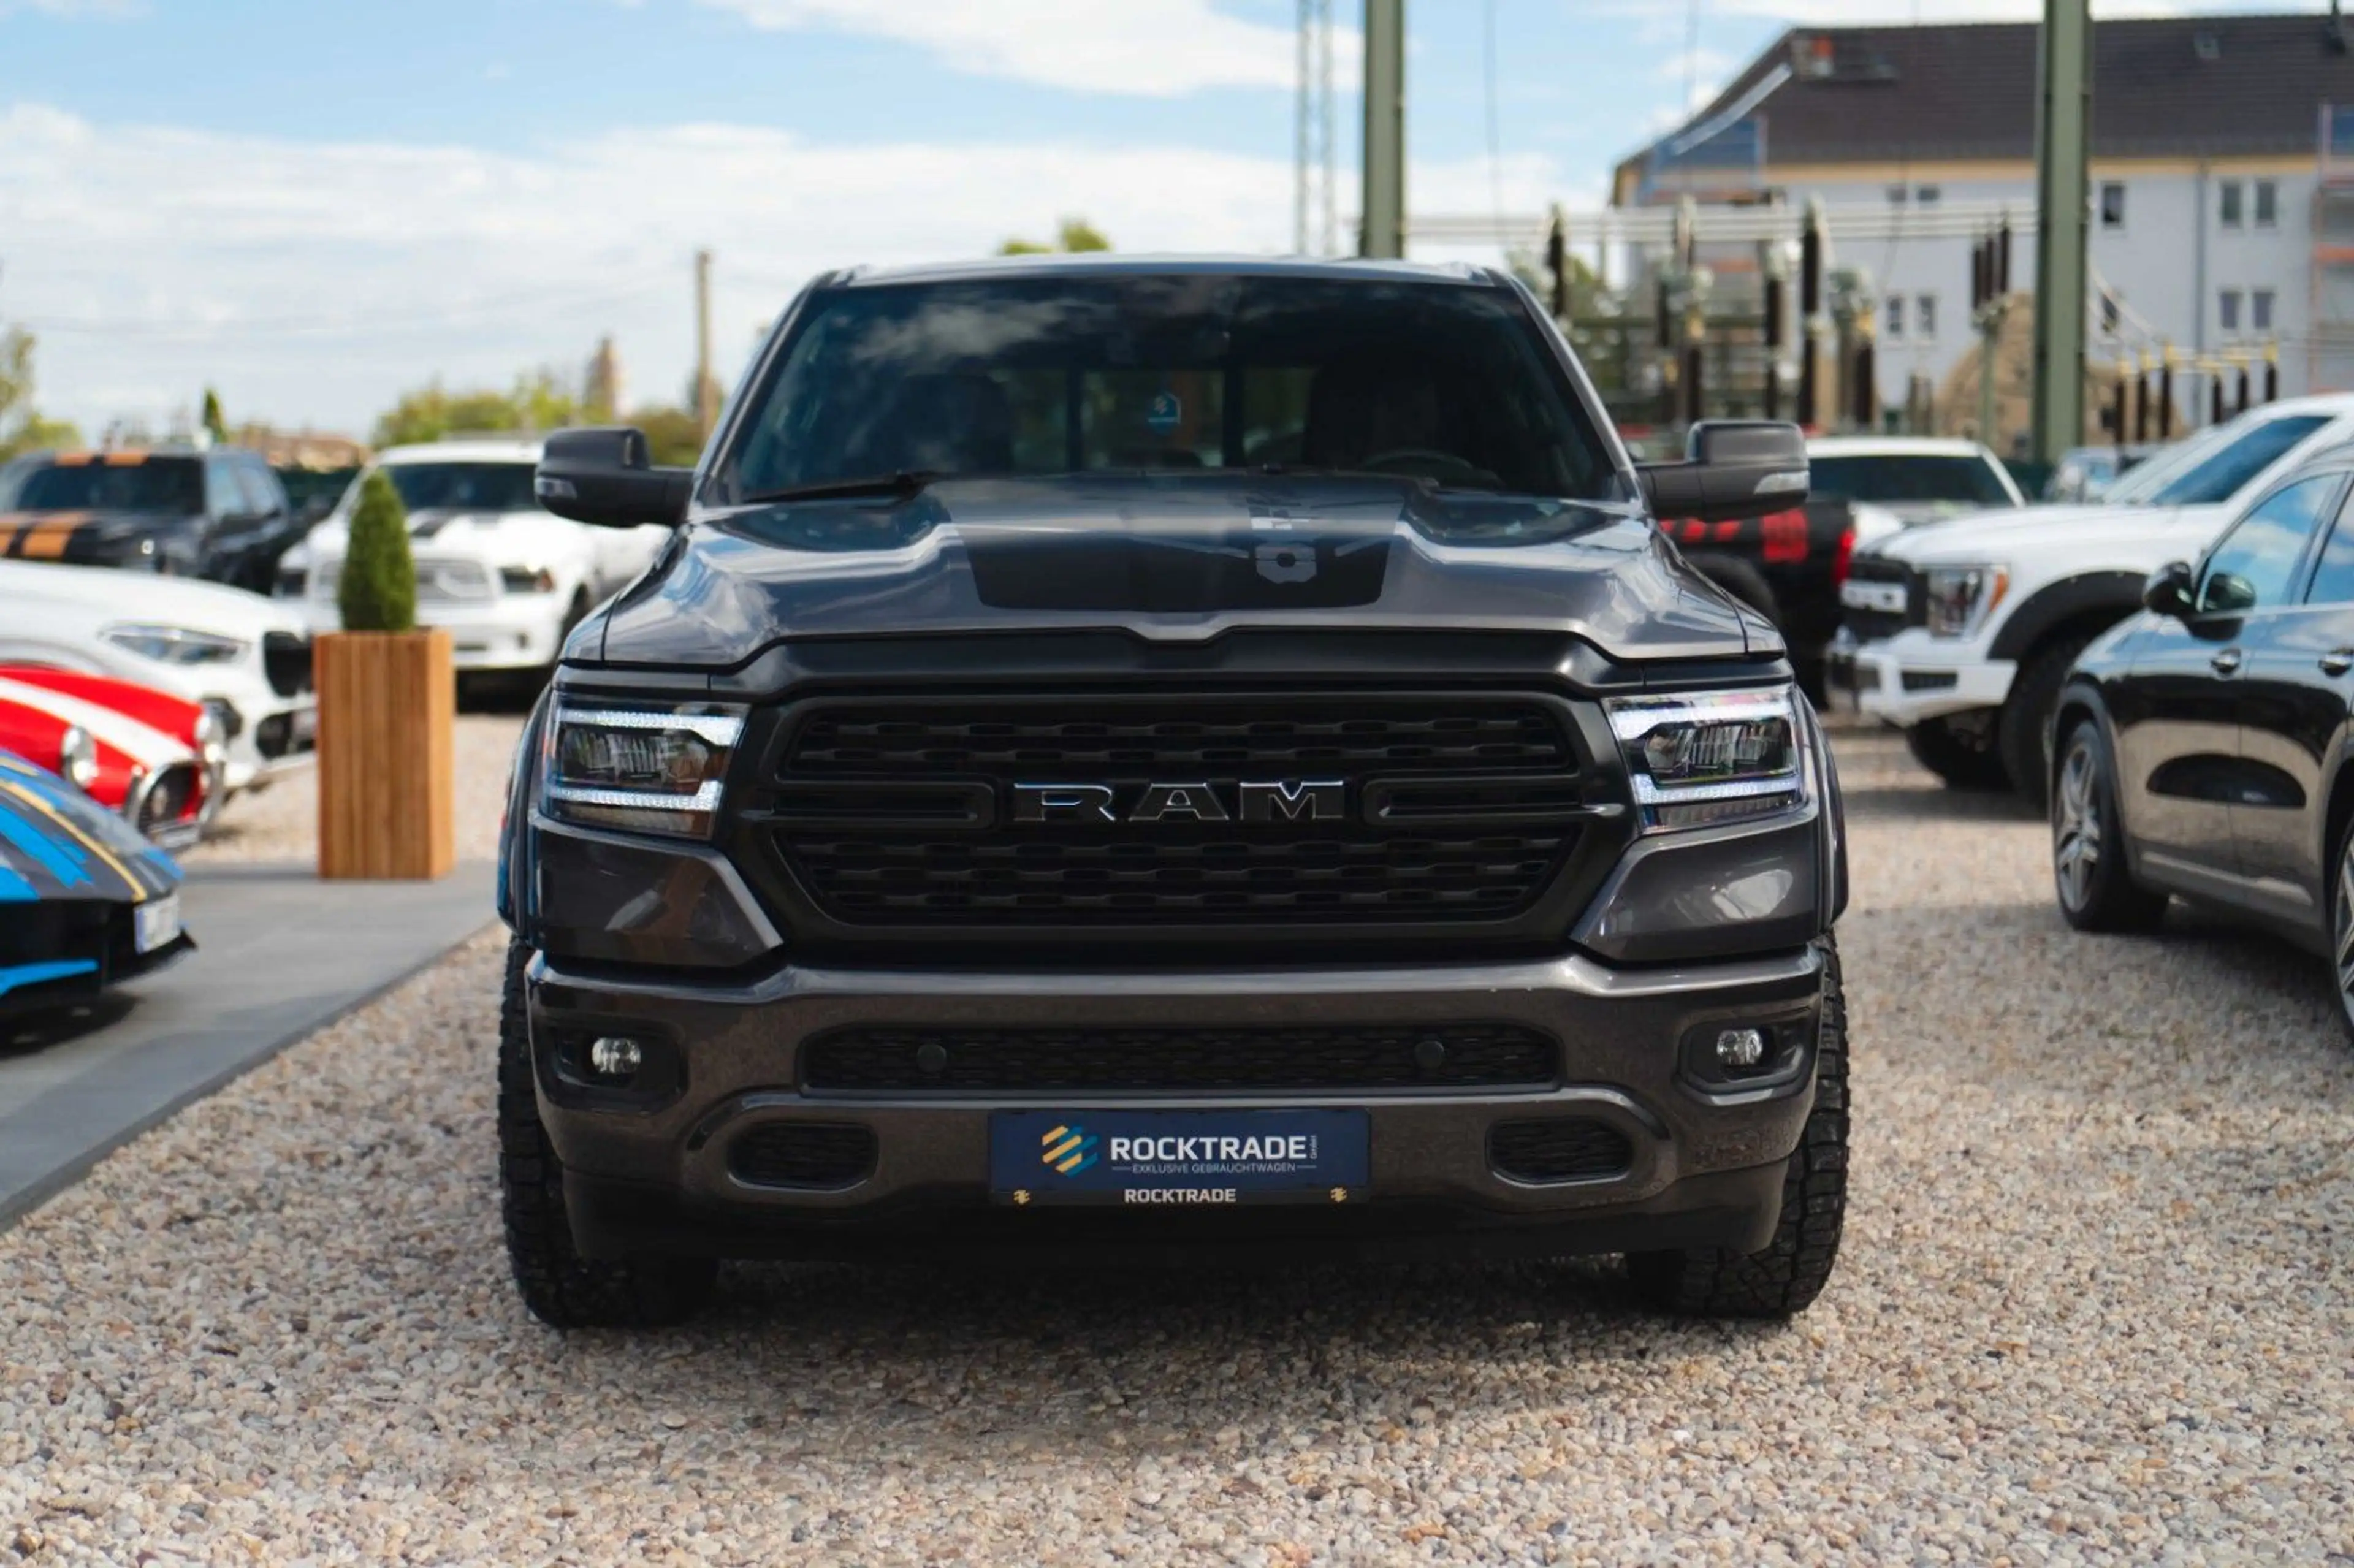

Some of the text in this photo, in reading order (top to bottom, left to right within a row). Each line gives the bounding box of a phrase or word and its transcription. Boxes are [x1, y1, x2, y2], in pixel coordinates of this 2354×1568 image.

[1013, 780, 1344, 821] RAM
[1111, 1136, 1306, 1160] ROCKTRADE
[1132, 1162, 1297, 1173] EXKLUSIVE GEBRAUCHTWAGEN
[1124, 1189, 1237, 1203] ROCKTRADE
